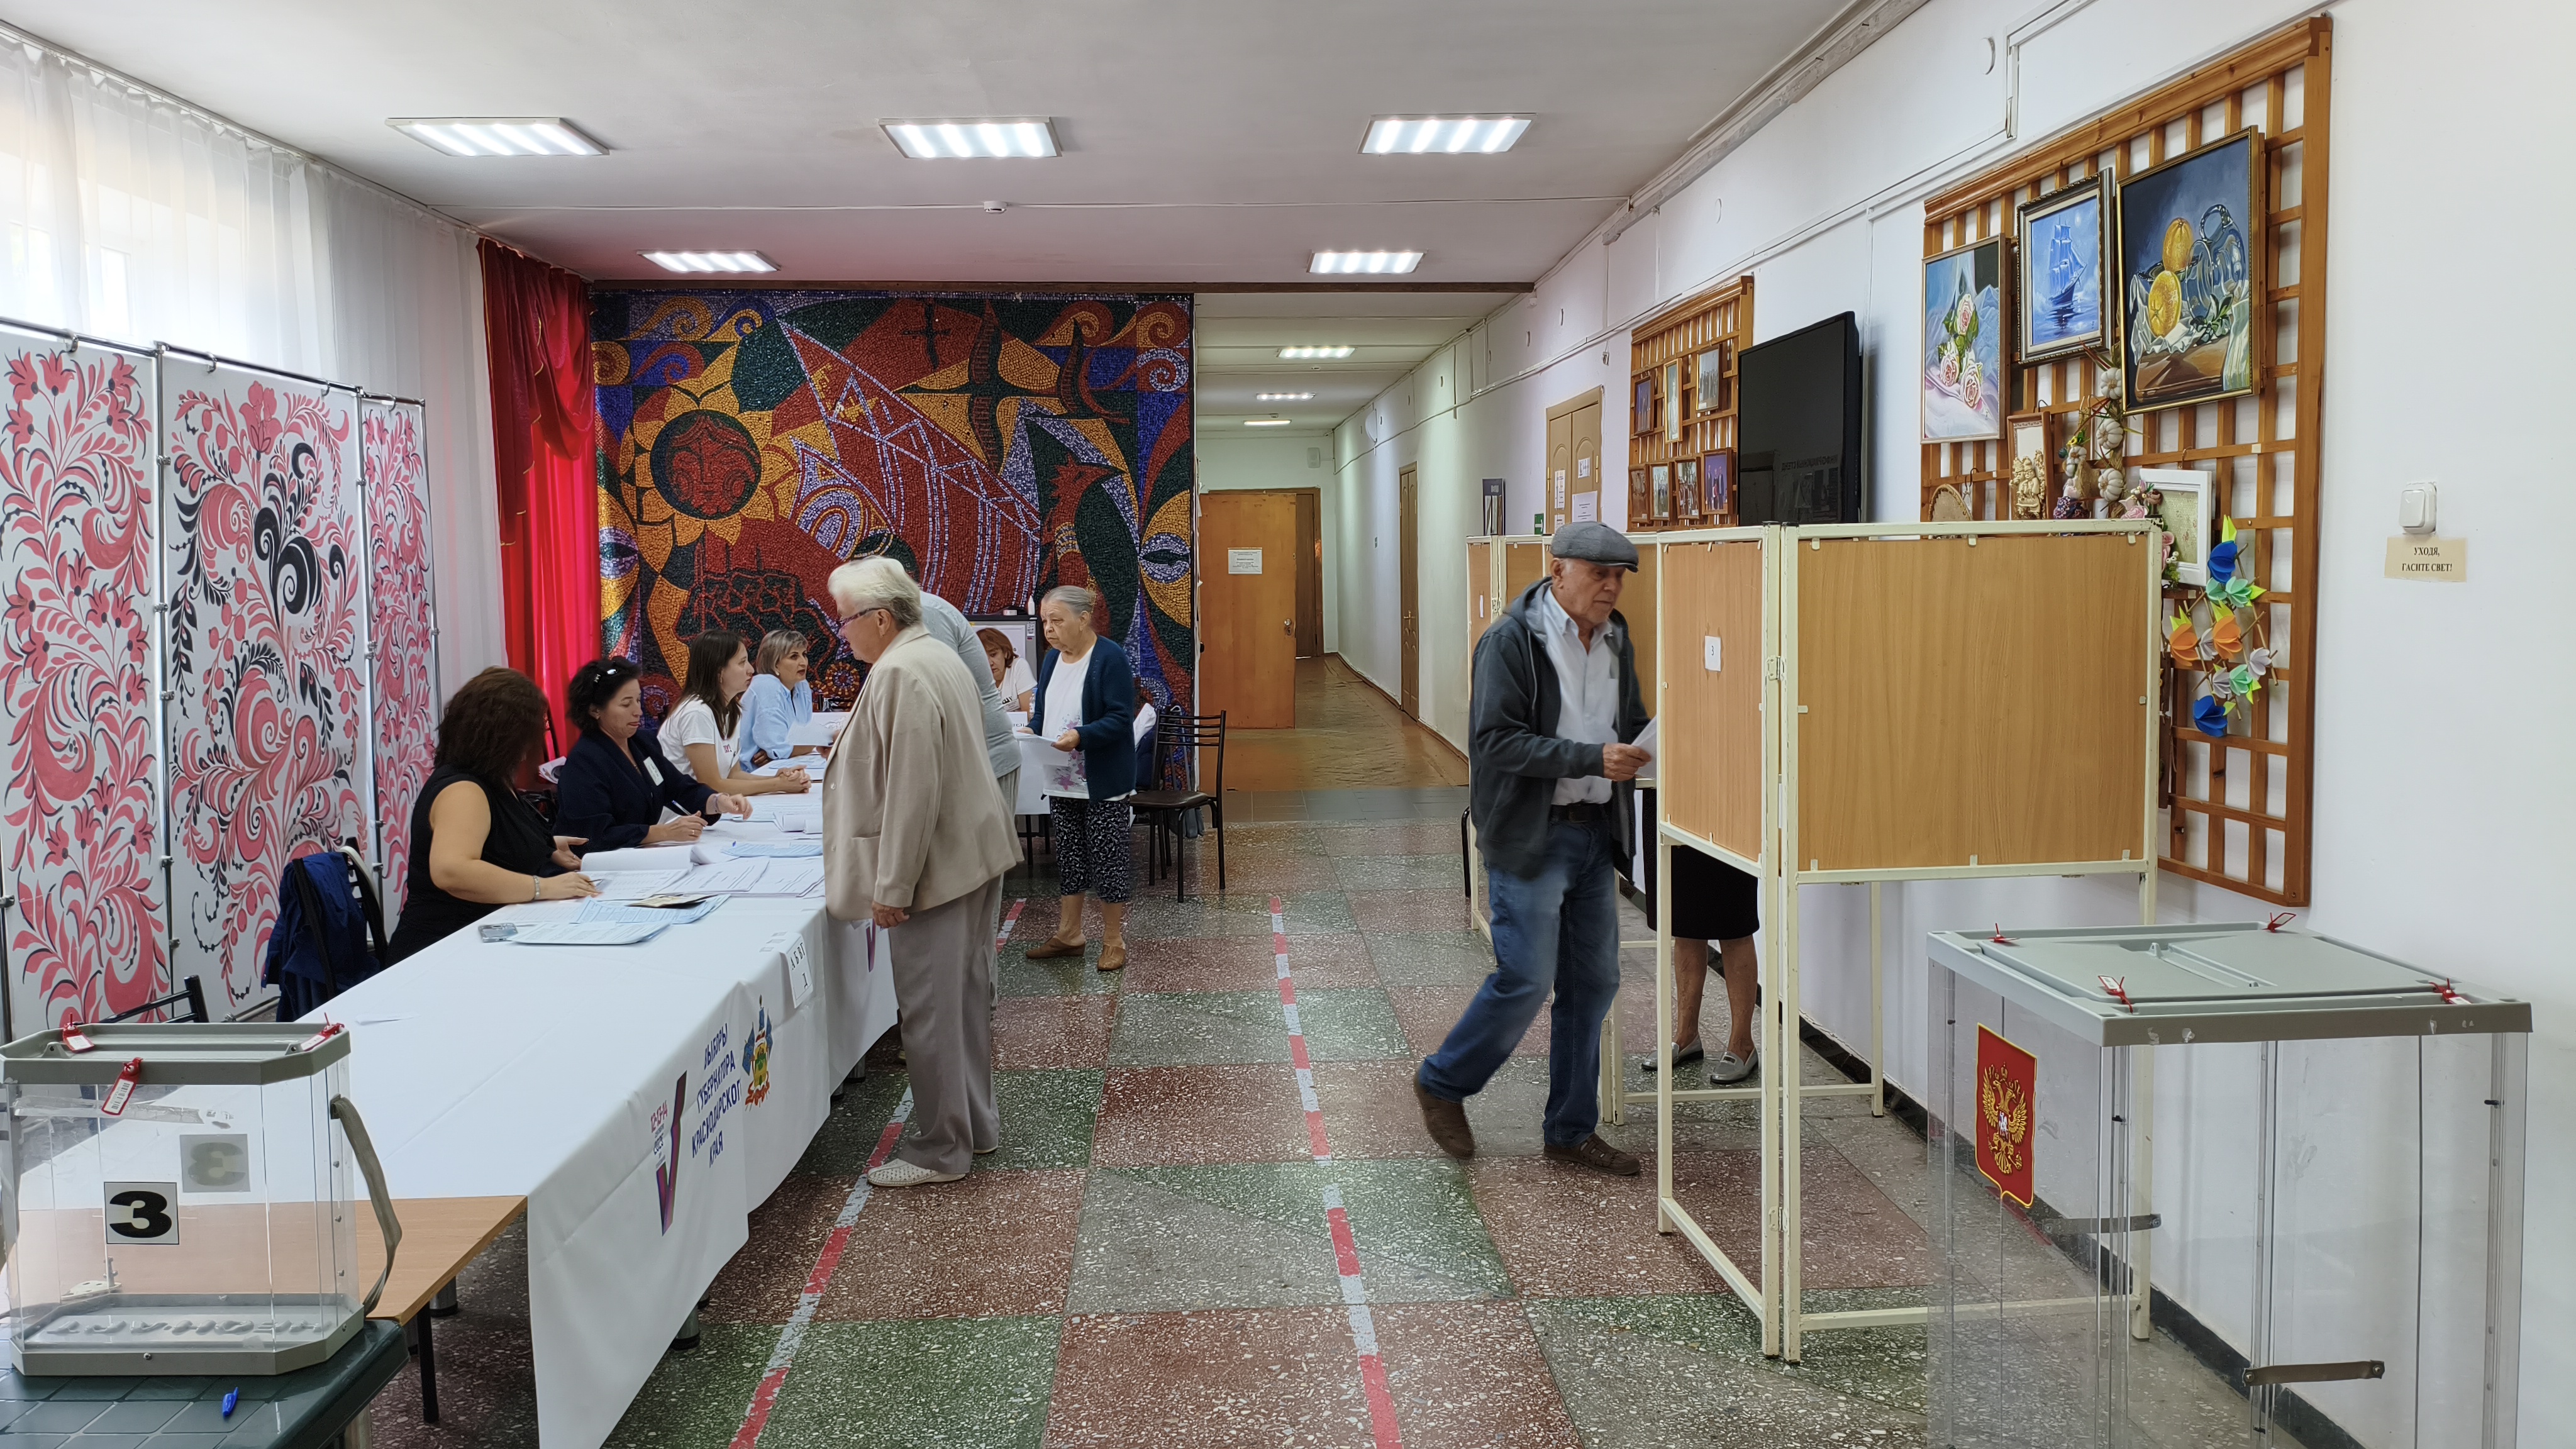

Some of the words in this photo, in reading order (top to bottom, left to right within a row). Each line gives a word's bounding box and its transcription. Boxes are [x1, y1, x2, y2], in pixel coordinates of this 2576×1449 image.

[2402, 563, 2430, 572] ГАСИТЕ
[2431, 563, 2453, 572] СВЕТ!
[2414, 547, 2440, 557] УХОДЯ,
[704, 1022, 728, 1070] ВЫБОРЫ
[697, 1050, 736, 1114] ГУБЕРНАТОРА
[692, 1077, 742, 1158] КРАСНОДАРСКОГ
[709, 1130, 723, 1169] КРАЯ
[109, 1191, 172, 1238] 3
